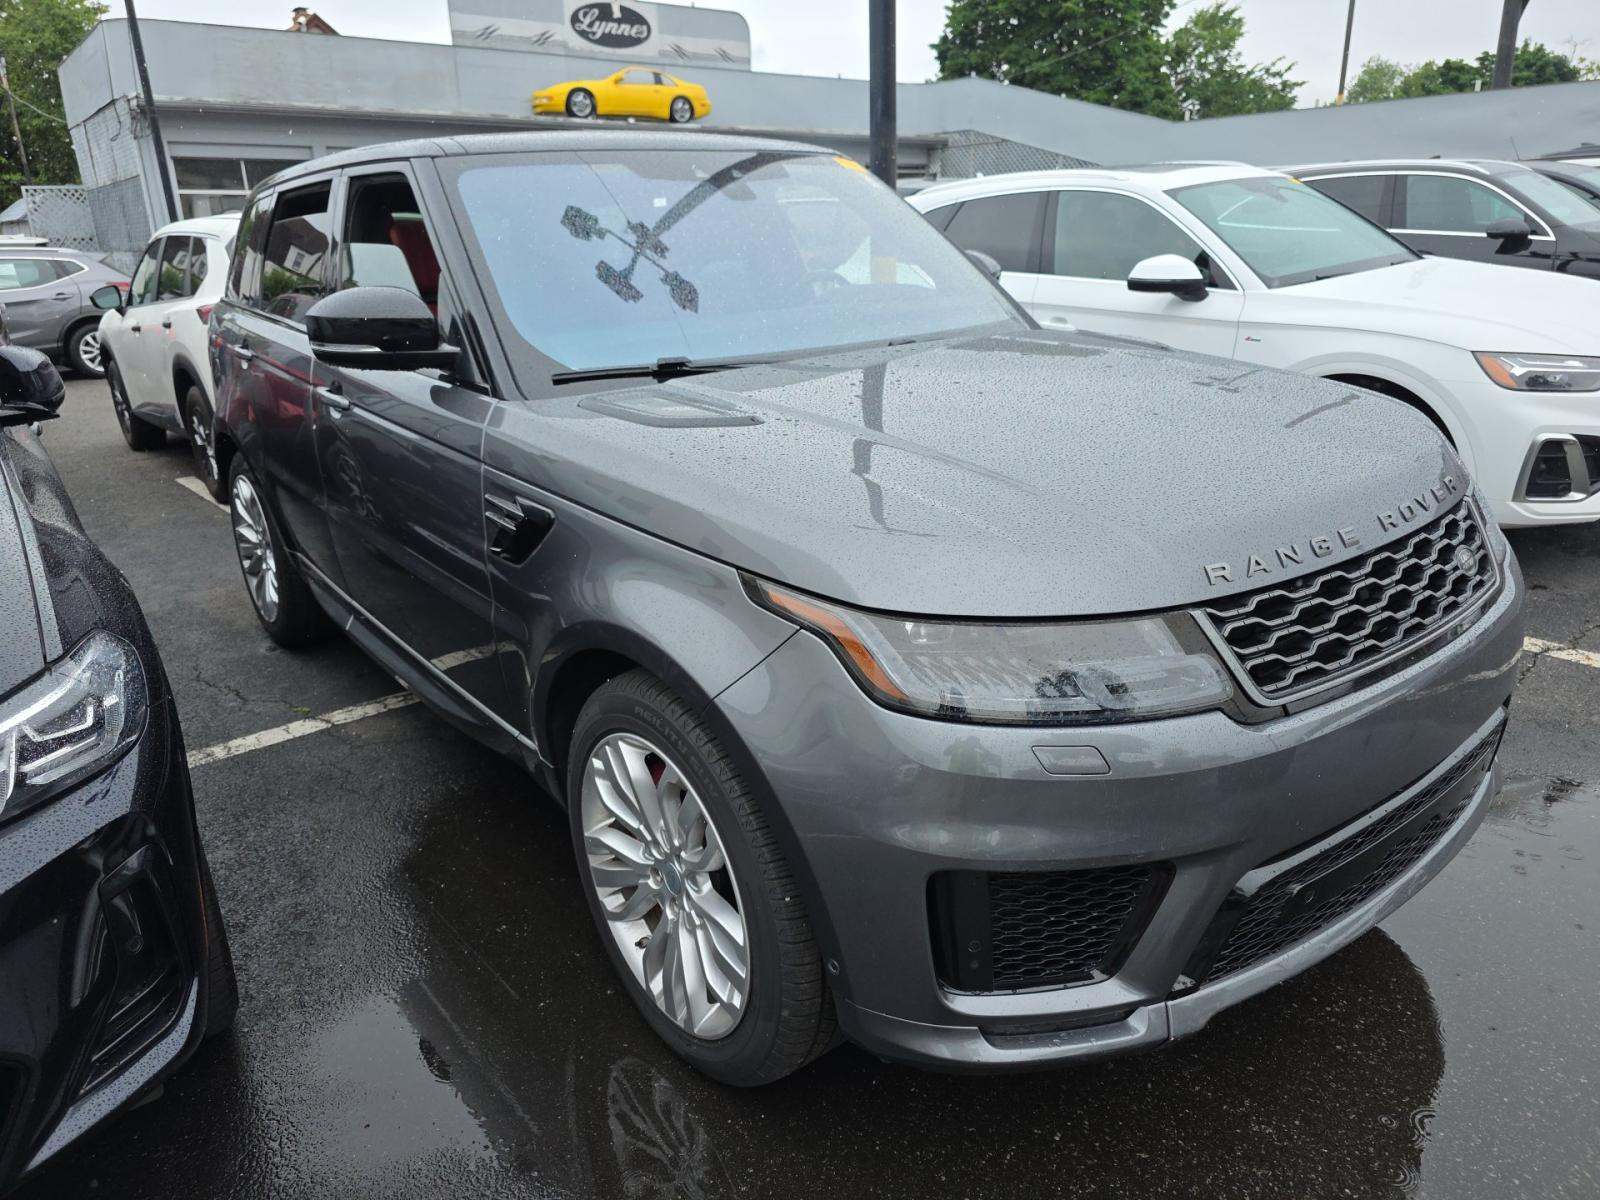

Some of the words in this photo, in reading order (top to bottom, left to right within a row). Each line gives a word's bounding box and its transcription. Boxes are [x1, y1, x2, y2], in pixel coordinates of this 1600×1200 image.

[574, 8, 648, 40] Lynnes
[1203, 525, 1362, 586] RANGE
[1376, 475, 1458, 532] ROVER
